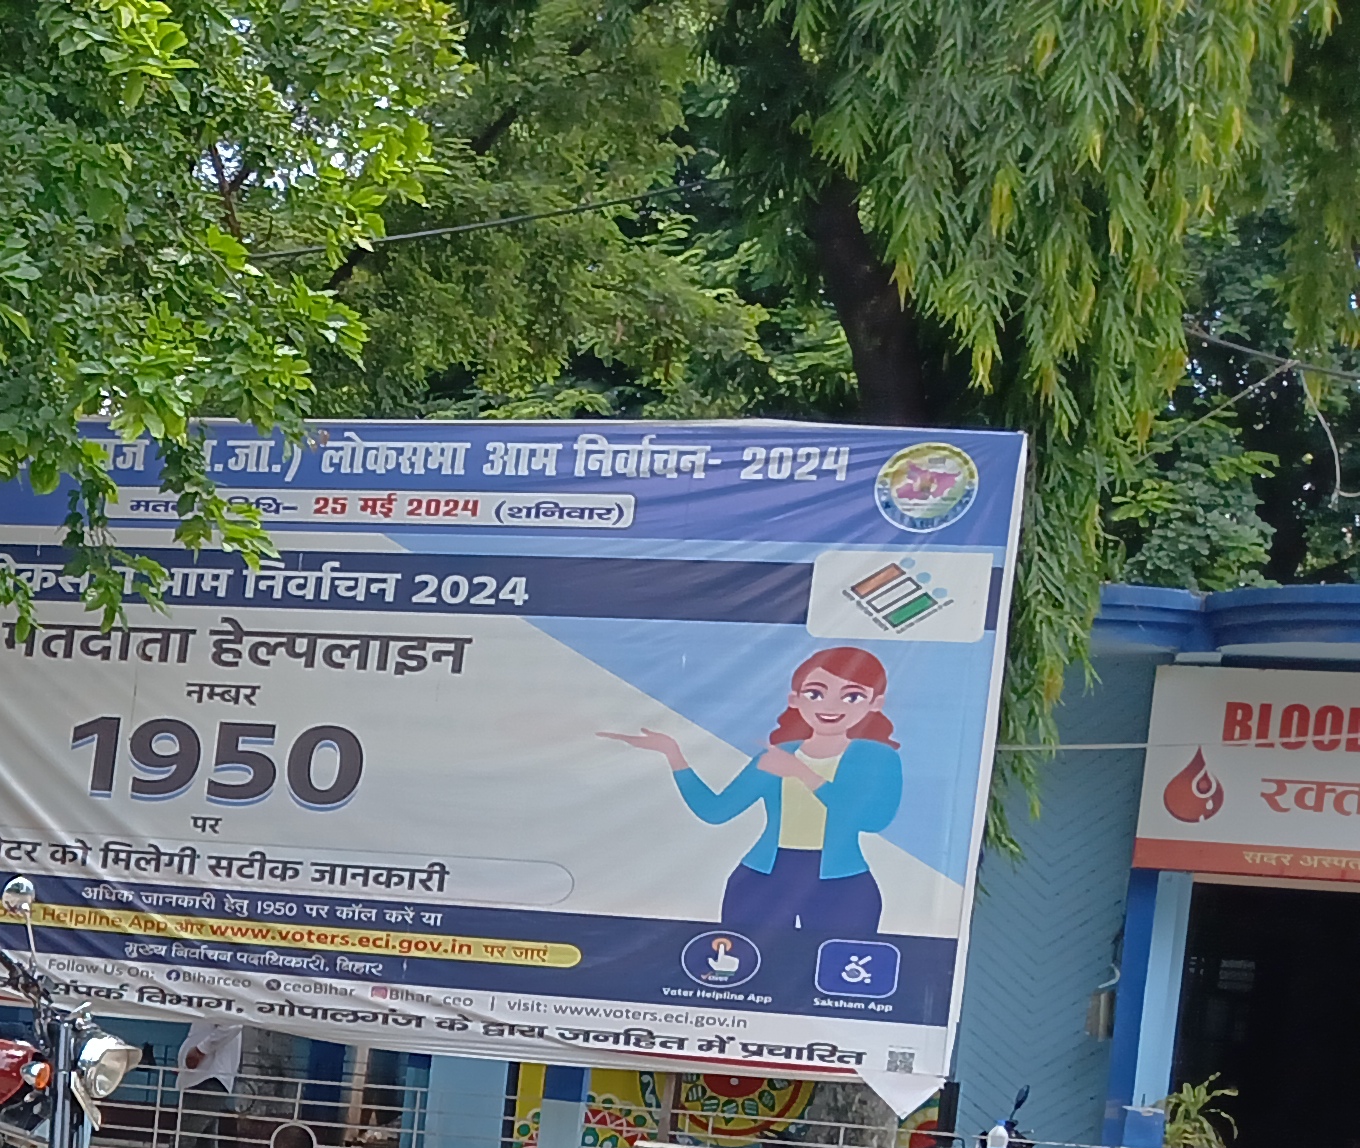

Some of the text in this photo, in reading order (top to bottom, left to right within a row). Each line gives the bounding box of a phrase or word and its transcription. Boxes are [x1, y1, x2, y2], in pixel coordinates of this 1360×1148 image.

[321, 432, 470, 475] लोकसभा
[483, 441, 563, 477] आम
[741, 446, 849, 482] 2024
[313, 496, 347, 515] 25
[358, 493, 398, 518] मई
[406, 498, 479, 517] 2024
[493, 499, 625, 527] (शनिवार)
[243, 559, 402, 603] निर्वाचन
[411, 574, 529, 606] 2024
[1, 616, 474, 676] मतदाता हेल्पलाइन
[185, 681, 260, 708] नम्बर
[70, 716, 364, 812] 1950
[190, 815, 223, 834] पर
[48, 838, 93, 867] को
[100, 840, 201, 876] मिलेगी
[207, 849, 303, 881] सटीक
[310, 861, 450, 893] जानकारी
[1242, 850, 1293, 865] सदर
[81, 884, 443, 927] अधिक जानकारी हेतु 1950 पर कॉल करें या
[42, 903, 122, 928] Helpline
[128, 915, 168, 932] App
[209, 923, 472, 955] www.voters.eci.gov.in
[483, 943, 506, 958] पर
[125, 941, 167, 958] मुख्य
[171, 942, 233, 963] निर्वाचन
[335, 956, 384, 977] बिहार
[47, 958, 99, 974] Follow
[102, 962, 123, 977] Us
[507, 998, 547, 1014] visit:
[553, 1002, 749, 1030] www.voters.eci.gov.in
[747, 993, 773, 1005] App
[812, 997, 893, 1013] Saksham App
[255, 999, 426, 1029] गोपालगंज
[434, 1014, 472, 1031] के
[556, 1023, 690, 1053] जनहित
[696, 1034, 735, 1053] में
[738, 1039, 867, 1066] प्रचारित
